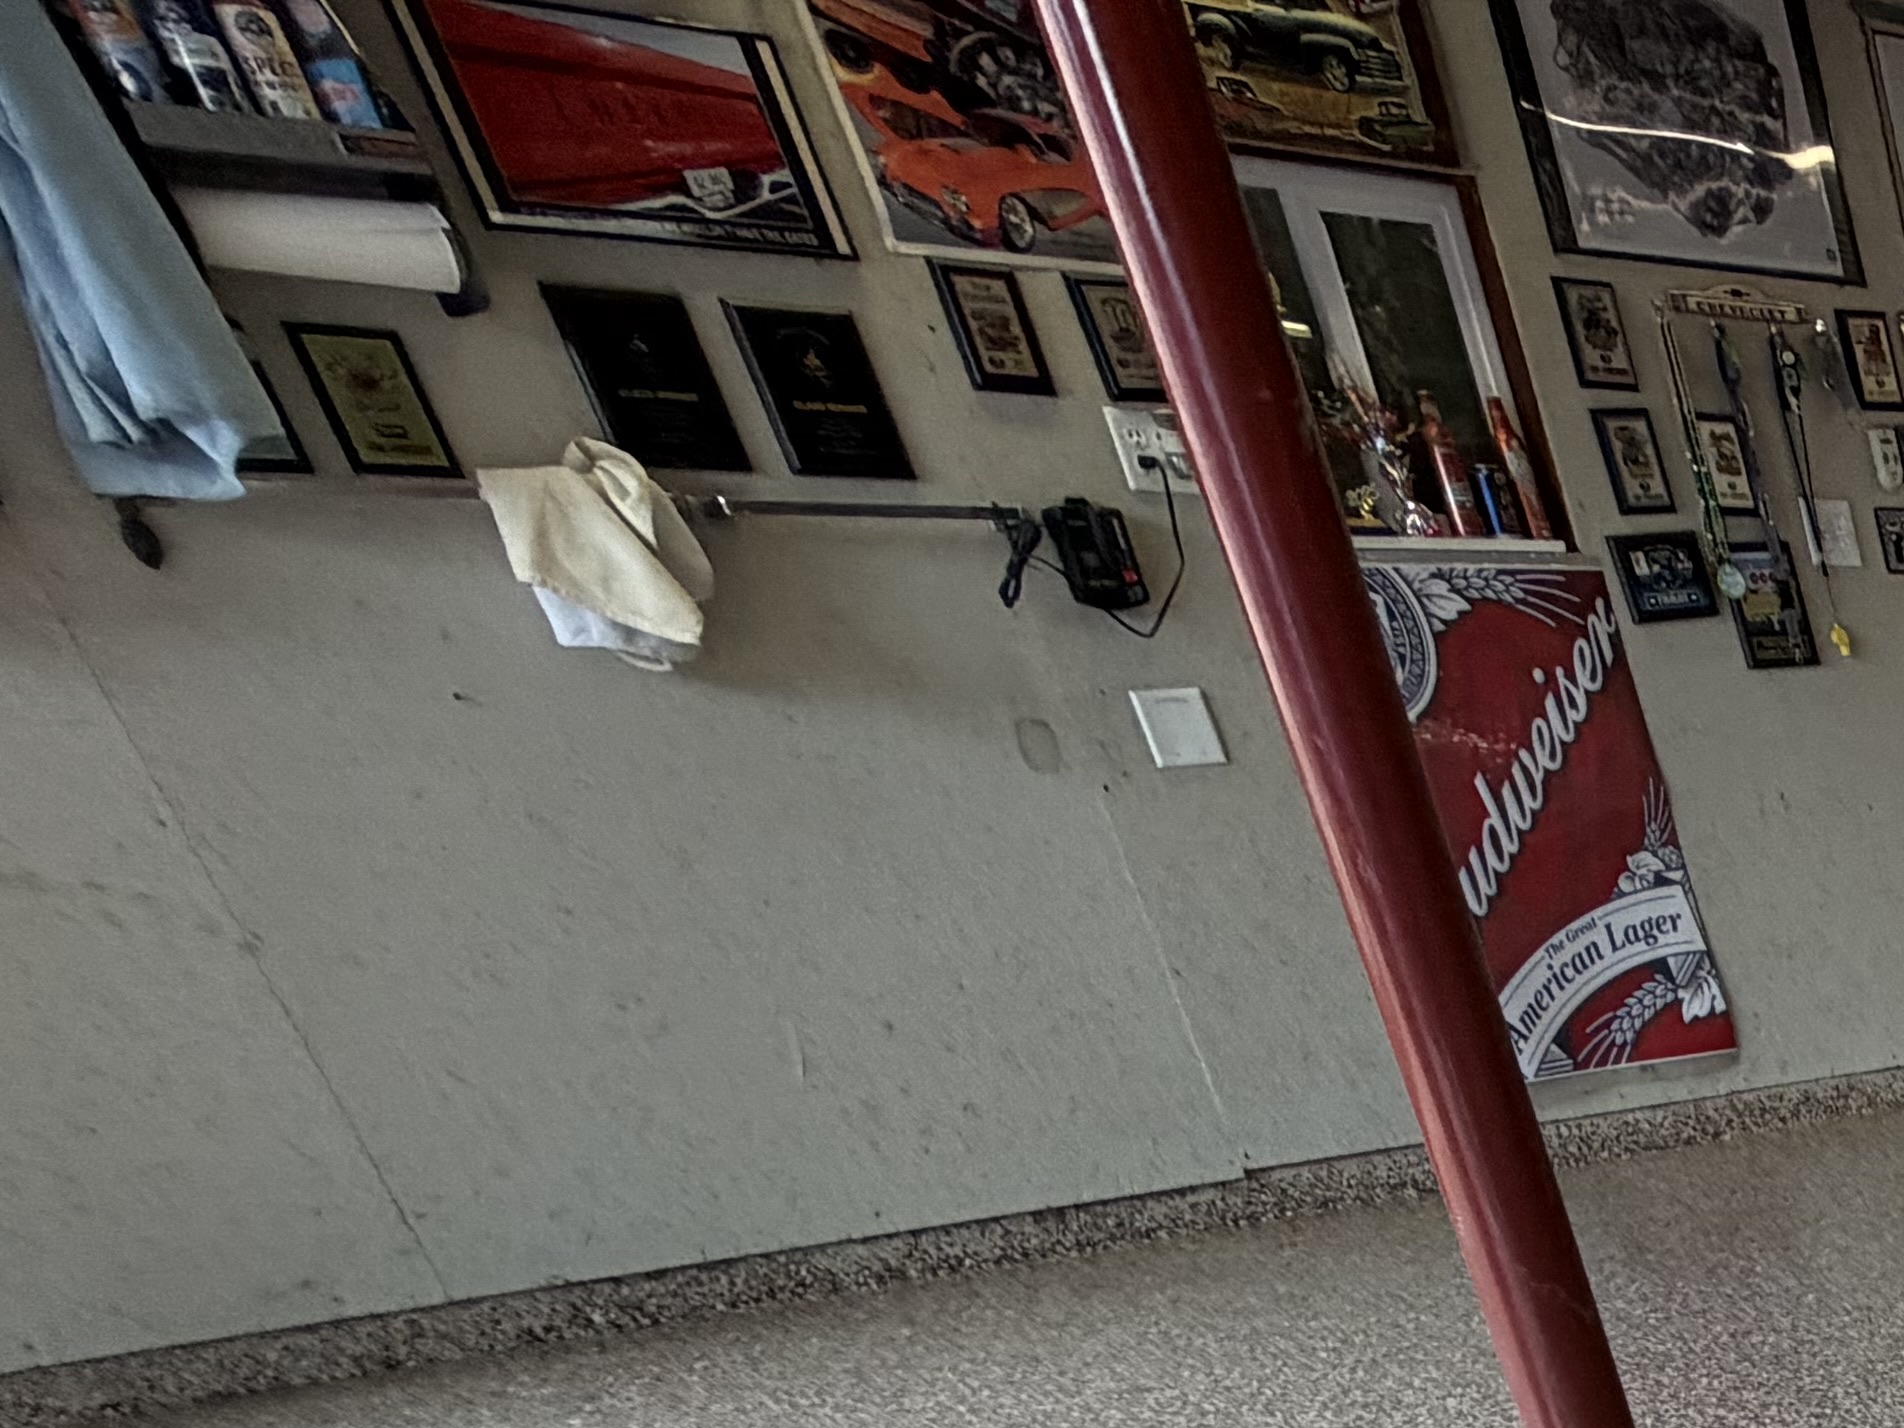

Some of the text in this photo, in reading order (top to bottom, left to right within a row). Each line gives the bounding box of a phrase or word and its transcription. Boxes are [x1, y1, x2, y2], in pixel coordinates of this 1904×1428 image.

[1458, 596, 1617, 917] udweiser
[1506, 912, 1682, 1056] American Lager
[1544, 916, 1598, 961] The Great
